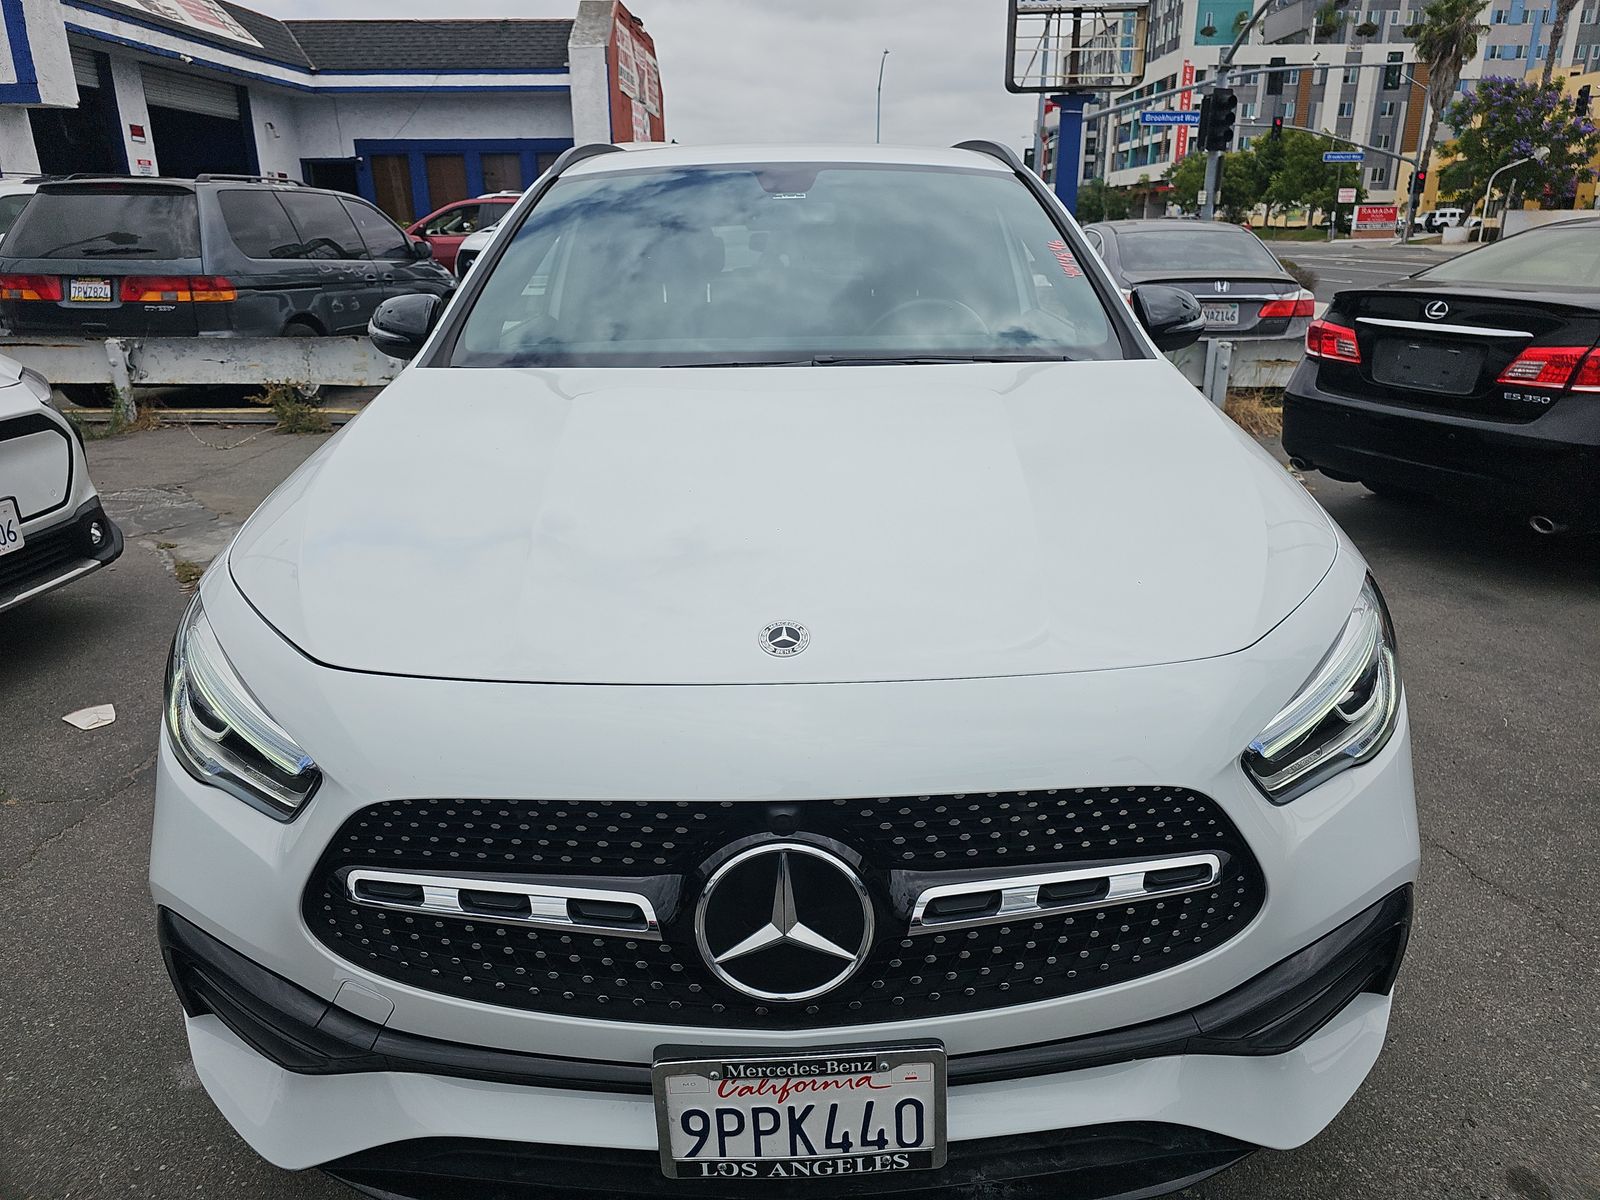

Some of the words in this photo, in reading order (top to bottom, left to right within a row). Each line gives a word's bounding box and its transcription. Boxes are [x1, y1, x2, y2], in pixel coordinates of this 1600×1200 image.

[1145, 113, 1184, 122] Brookhurst
[1184, 114, 1200, 123] Way
[1361, 207, 1394, 215] RAMADA
[1503, 392, 1521, 401] ES
[1523, 394, 1551, 404] 350
[726, 1060, 873, 1079] Mercedes-Benz
[717, 1074, 892, 1104] California
[680, 1097, 925, 1158] 9PPK440
[700, 1161, 758, 1178] LOS
[767, 1153, 911, 1178] ANGELES
